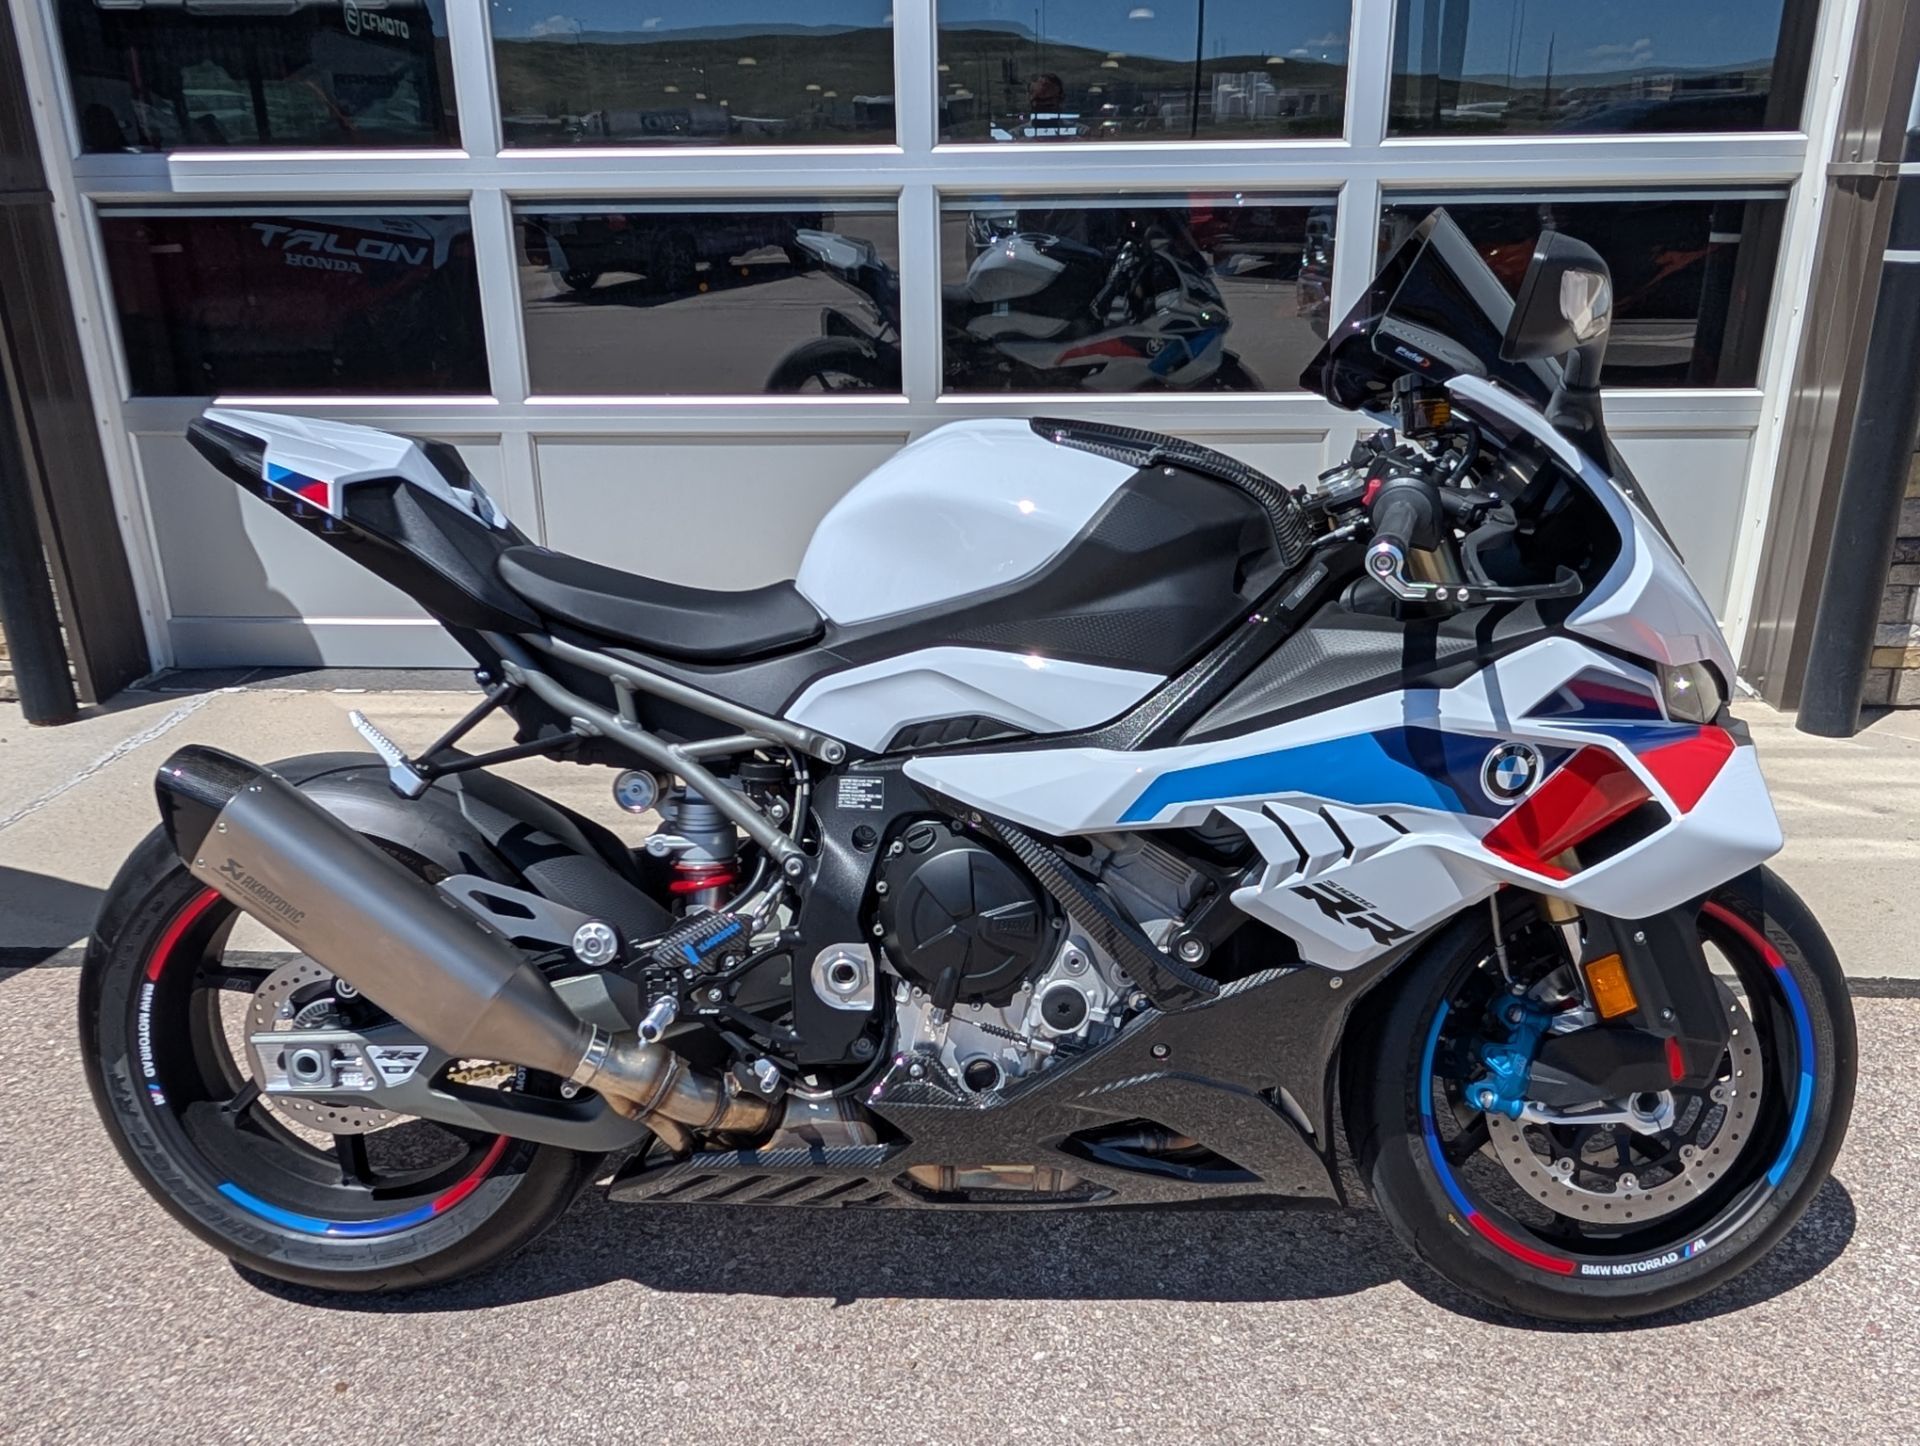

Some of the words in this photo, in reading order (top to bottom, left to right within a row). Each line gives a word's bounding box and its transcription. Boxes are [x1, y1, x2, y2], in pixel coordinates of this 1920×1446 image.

[361, 11, 410, 39] CFMOTO
[251, 222, 428, 265] TALON
[284, 252, 363, 274] HONDA
[1288, 882, 1416, 947] RR
[140, 983, 156, 1012] BMW
[138, 1012, 156, 1078] MOTORRAD
[1581, 1264, 1611, 1276] BMW
[1612, 1252, 1679, 1275] MOTORRAD
